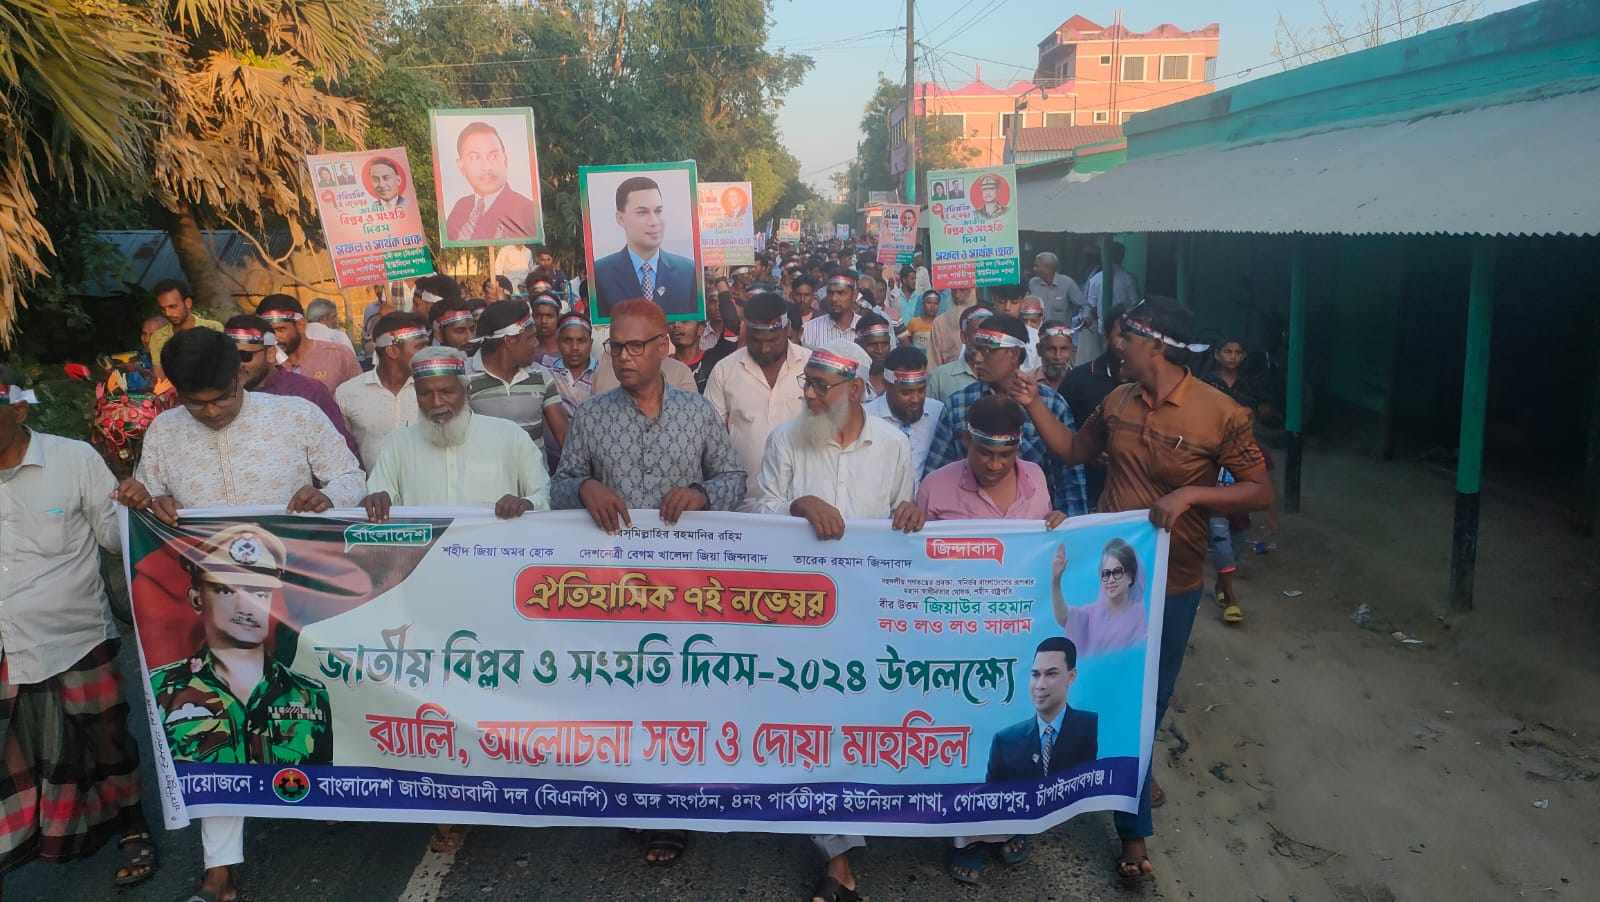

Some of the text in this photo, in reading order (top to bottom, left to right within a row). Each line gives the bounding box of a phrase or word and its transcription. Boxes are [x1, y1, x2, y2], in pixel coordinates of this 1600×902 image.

[350, 527, 429, 543] বাংলাদেশ
[673, 528, 714, 541] রহমানির
[717, 531, 743, 543] রহিম
[440, 543, 554, 558] শহীদ জিয়া অমর হোক
[579, 546, 768, 564] দেশনেত্রী বেগম খালেদা জিয়া জিন্দাবাদ
[931, 539, 998, 557] জিন্দাবাদ
[793, 554, 912, 569] তারেক রহমান জিন্দাবাদ
[526, 571, 828, 622] ঐতিহাসিক ৭ই নভেম্বর
[879, 596, 1033, 616] বীর উত্তম জিয়াউর রহমান
[878, 618, 1033, 634] লও লও লও সালাম
[313, 623, 1017, 705] জাতীয় বিপ্লব ও সংহতি দিবস-২০২৪ উপলক্ষ্যে
[476, 720, 634, 766] আলোচনা
[641, 719, 708, 765] সভা
[714, 720, 741, 765] ও
[752, 722, 833, 769] দোয়া
[840, 710, 972, 771] মাহফিল
[317, 775, 393, 799] বাংলাদেশ
[399, 777, 498, 804] জাতীয়তাবাদী
[503, 786, 528, 804] দল
[535, 784, 608, 812] (বিএনপি)
[615, 793, 628, 806] ও
[632, 791, 661, 808] অঙ্গ
[667, 786, 724, 812] সংগঠন,
[731, 794, 761, 810] ৪নং
[767, 786, 837, 814] পার্বতীপুর
[842, 788, 902, 813] ইউনিয়ন
[908, 791, 947, 816] শাখা,
[954, 788, 1030, 814] গোমস্তাপুর,
